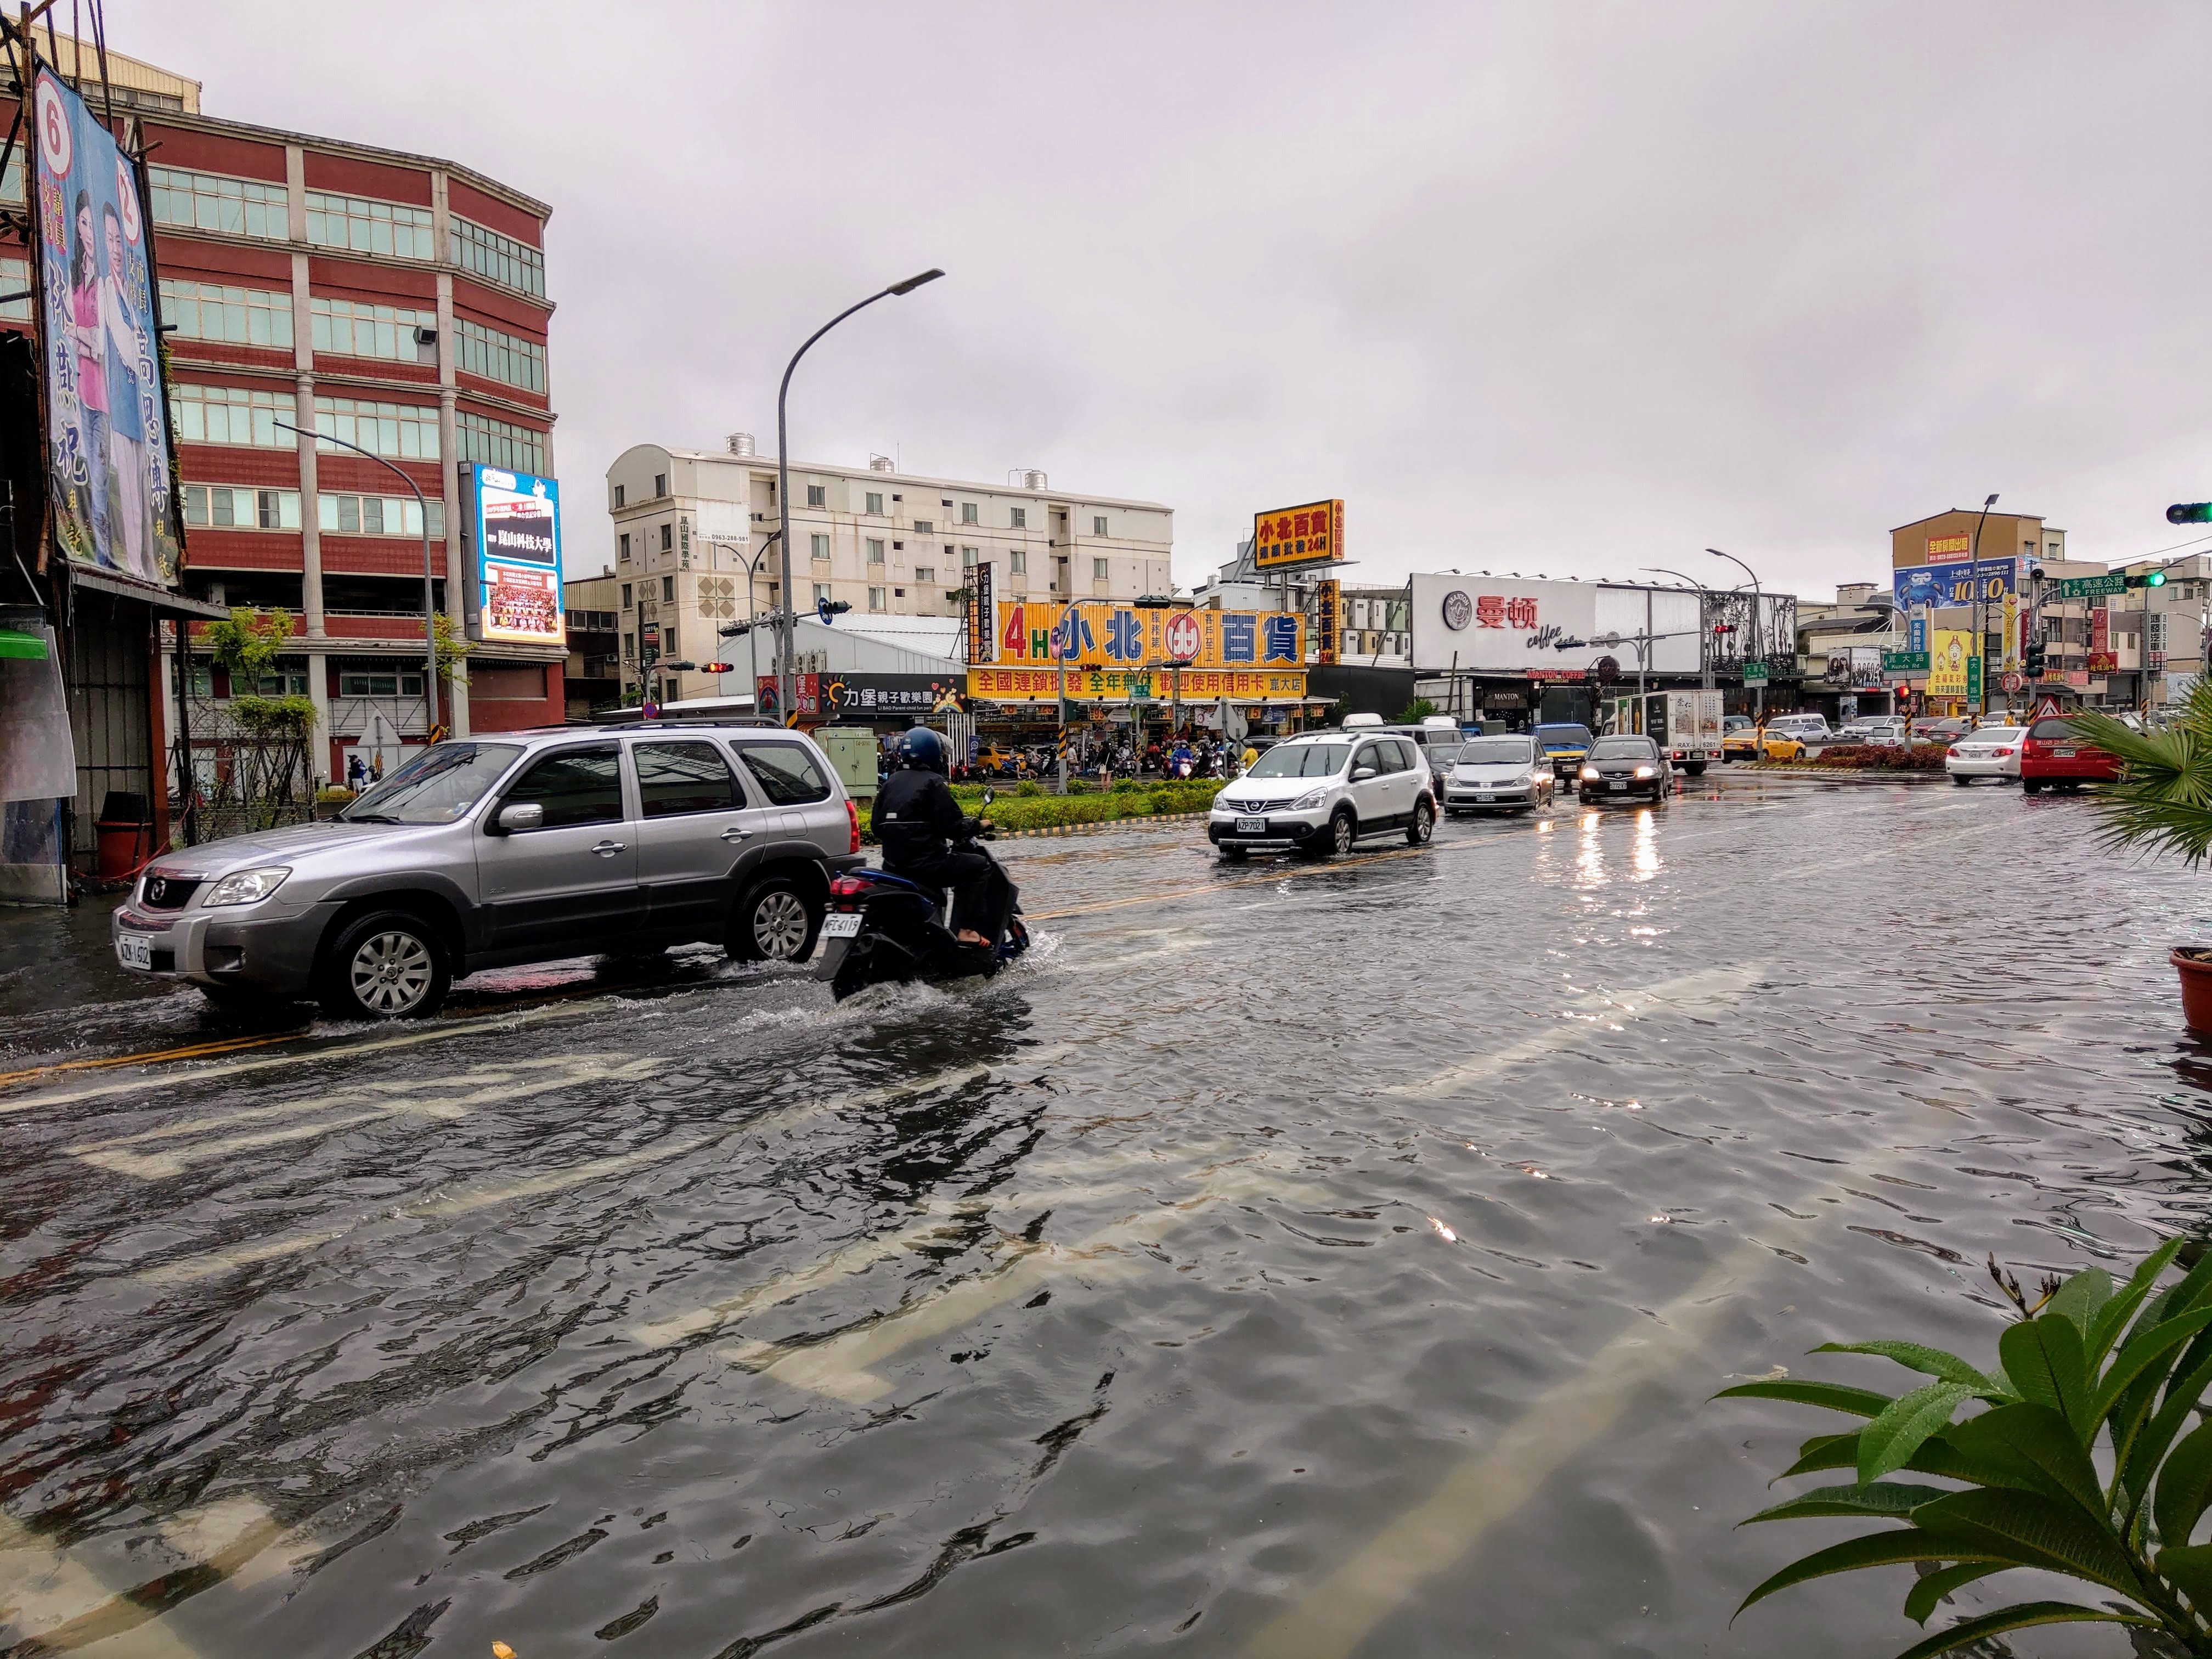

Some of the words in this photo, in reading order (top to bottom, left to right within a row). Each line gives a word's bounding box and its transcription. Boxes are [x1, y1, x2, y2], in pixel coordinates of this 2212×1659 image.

[46, 99, 61, 156] 6
[118, 159, 133, 225] 2
[1259, 510, 1328, 544] 小北百貨
[1334, 501, 1343, 556] 小北百貨
[498, 529, 553, 553] 崑山科技大學
[1260, 540, 1306, 560] 連鎖批發
[1307, 535, 1327, 552] 24H
[1929, 538, 1968, 554] 全新房間出租
[1954, 581, 1974, 601] 10
[2082, 577, 2124, 589] 高速公路
[1321, 583, 1333, 650] 小北百貨
[998, 606, 1048, 659] 4H
[1063, 608, 1143, 661] 小北
[1221, 614, 1299, 663] 百貨
[1152, 611, 1160, 658] 服務第一
[1205, 613, 1214, 662] 客戶至上
[1527, 624, 1562, 650] coffee
[2150, 614, 2160, 651] 鴻發汽車
[1889, 653, 1925, 663] 崑大路
[978, 671, 1082, 692] 全國連鎖批發
[1090, 673, 1153, 692] 全年無休
[1160, 673, 1263, 692] 歡迎使用信用卡
[1269, 678, 1301, 691] 崑大店
[1527, 670, 1558, 679] MANTON
[1561, 670, 1585, 679] COFFEE
[1253, 708, 1259, 717] 5
[1238, 822, 1263, 830] AZP-7021
